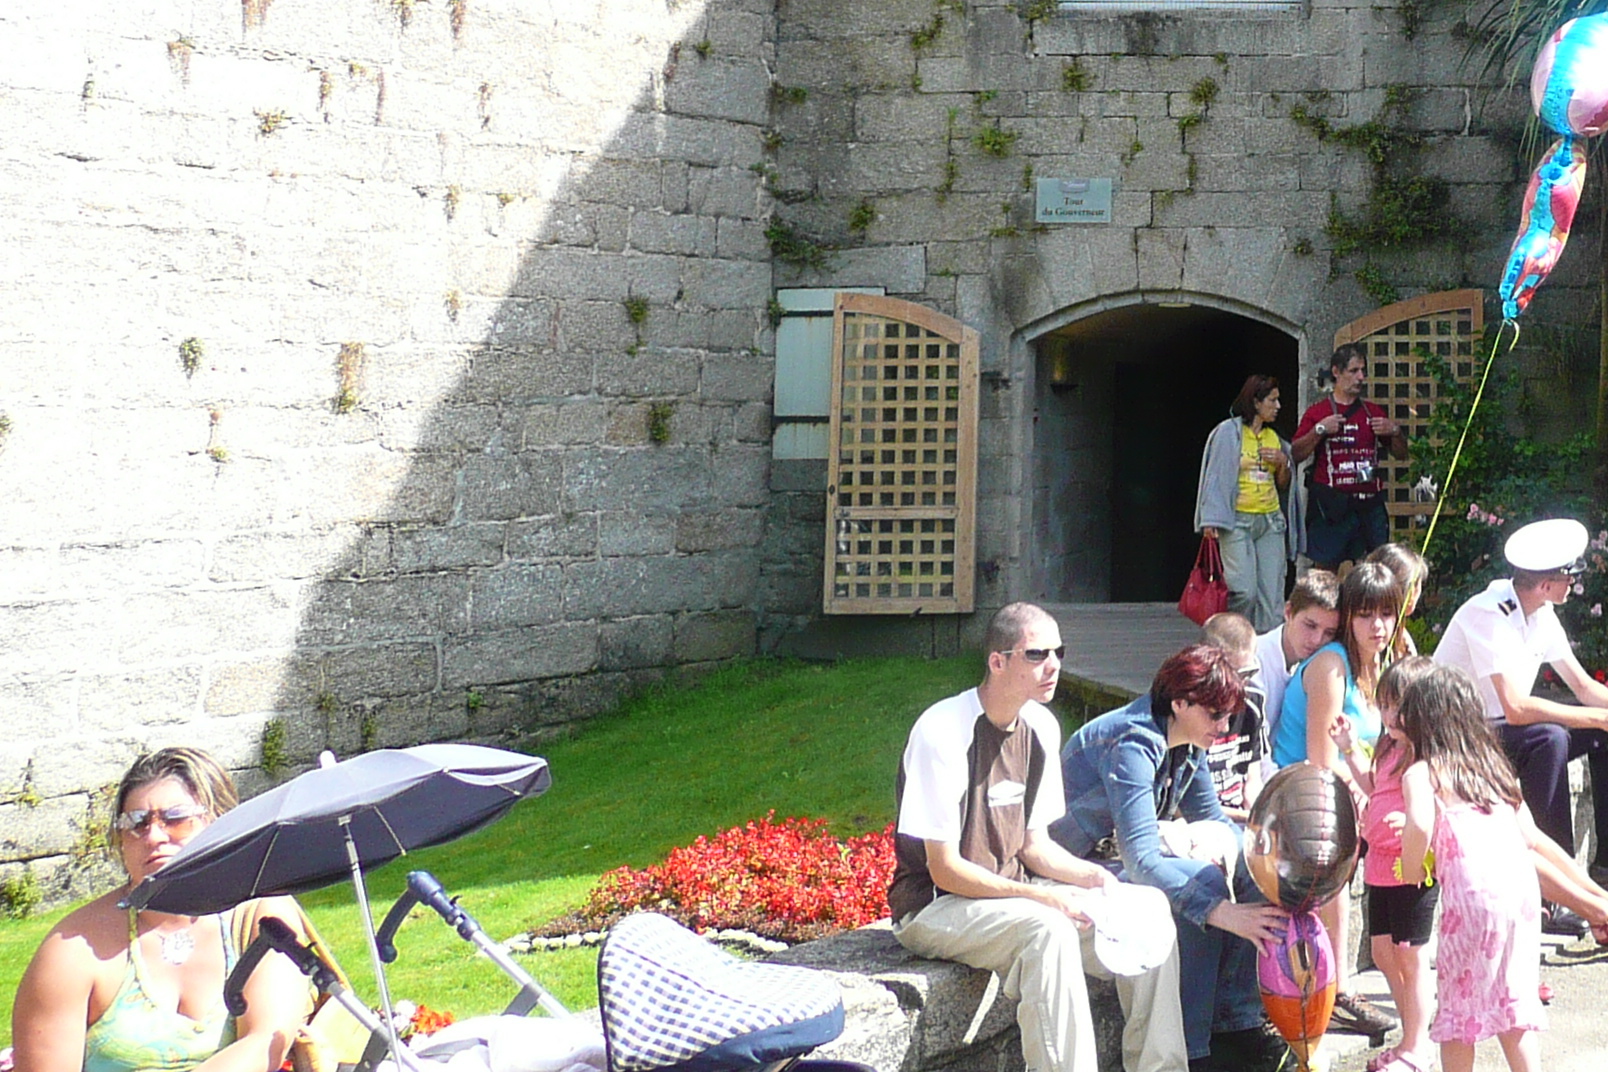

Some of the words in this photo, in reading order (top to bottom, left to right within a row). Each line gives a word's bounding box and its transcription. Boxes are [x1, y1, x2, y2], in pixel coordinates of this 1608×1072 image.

[1063, 196, 1084, 206] Tour
[1041, 206, 1053, 216] du
[1055, 206, 1105, 216] Gouverneur
